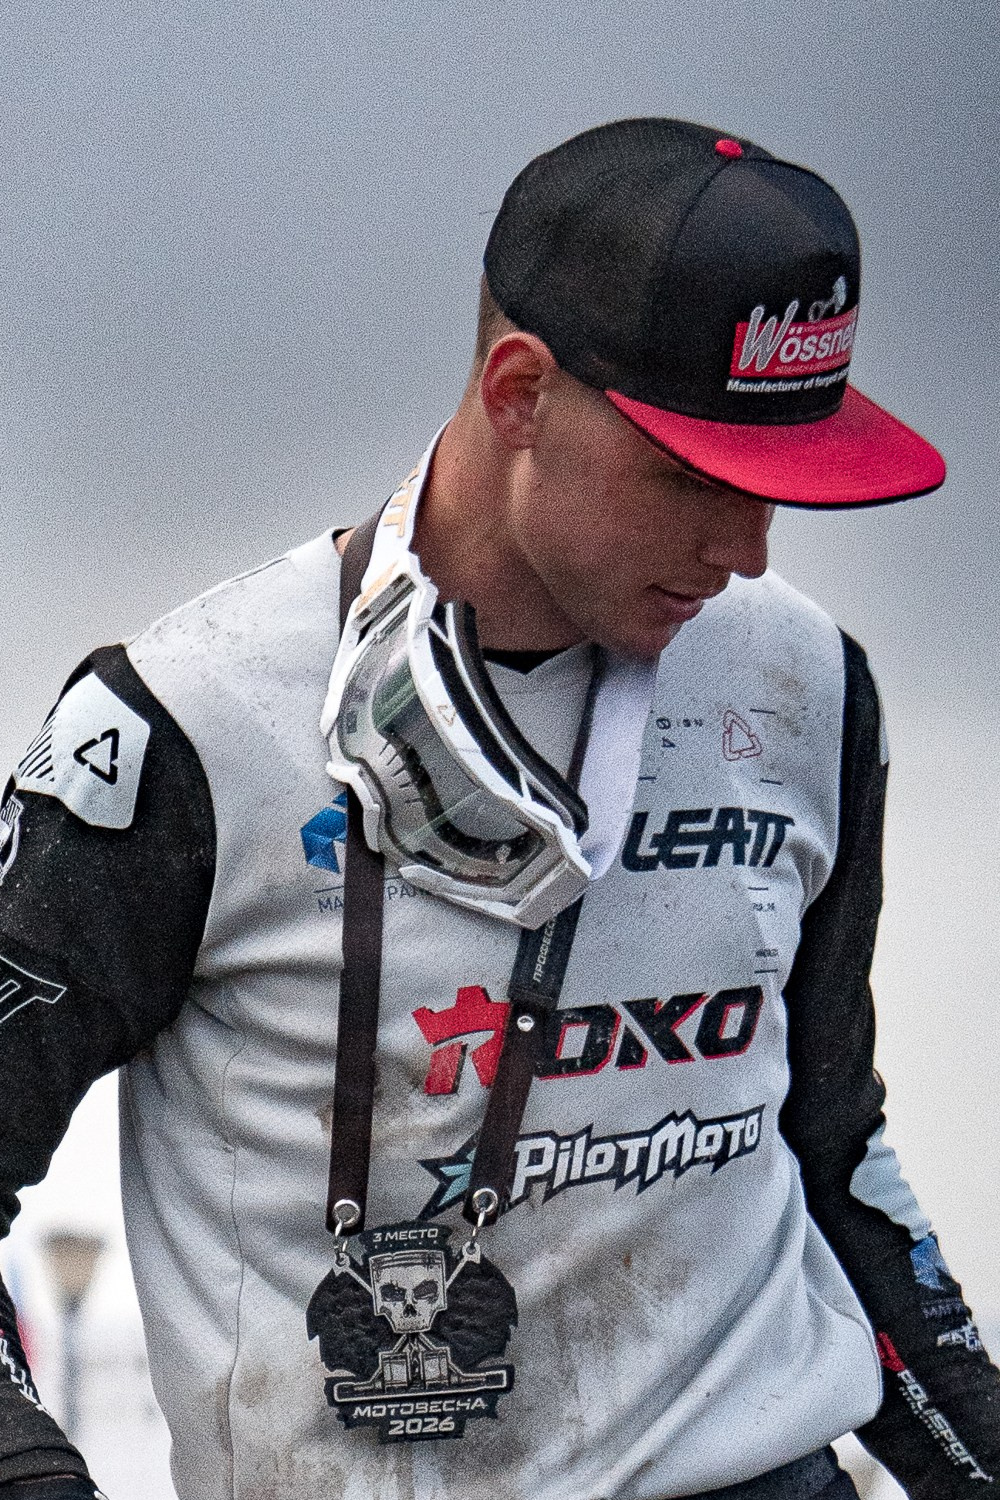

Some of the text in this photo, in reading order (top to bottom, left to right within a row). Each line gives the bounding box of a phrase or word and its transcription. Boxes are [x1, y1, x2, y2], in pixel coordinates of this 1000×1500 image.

[621, 806, 796, 872] LEATT
[373, 1228, 438, 1242] 3 МЕСТО
[353, 1397, 488, 1419] МОТОВЕСНА
[388, 1417, 455, 1436] 2026
